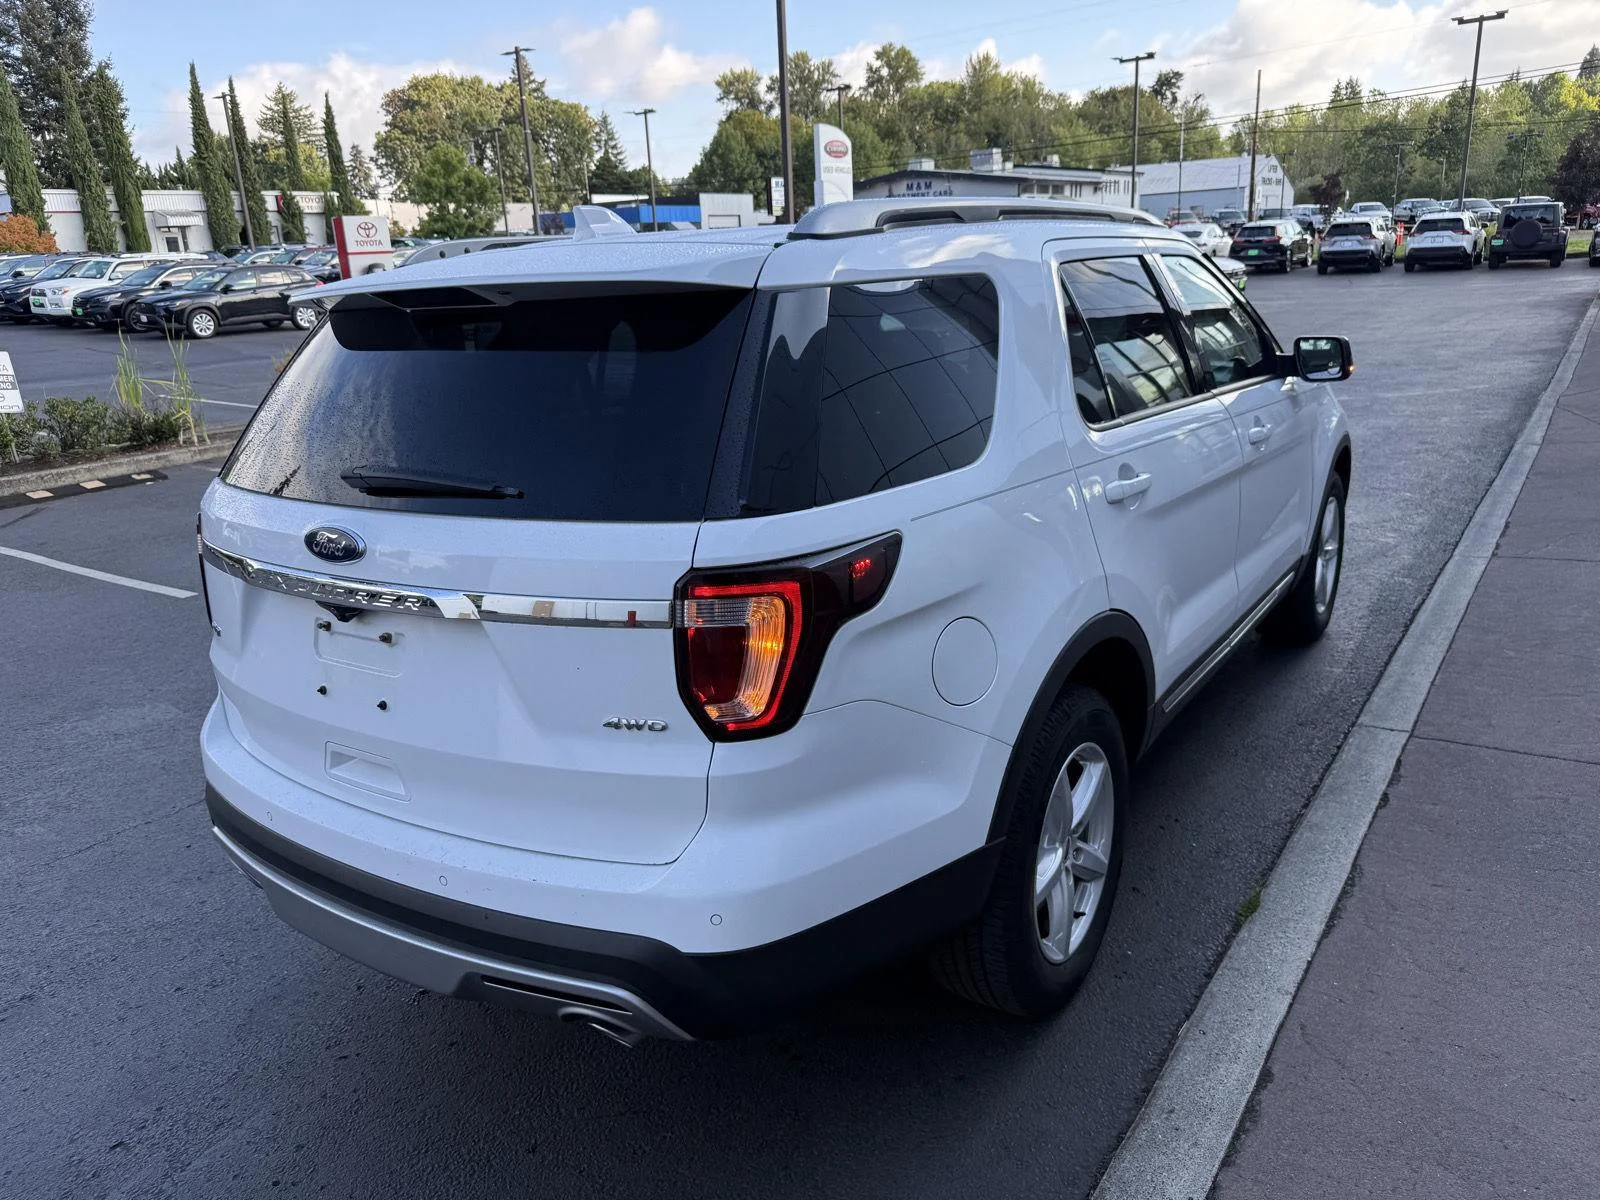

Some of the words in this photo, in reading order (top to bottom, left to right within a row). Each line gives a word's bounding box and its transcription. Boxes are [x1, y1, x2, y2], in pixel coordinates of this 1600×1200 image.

[355, 240, 384, 248] TOYOTA
[313, 530, 346, 557] Ford
[603, 717, 668, 731] 4WD
